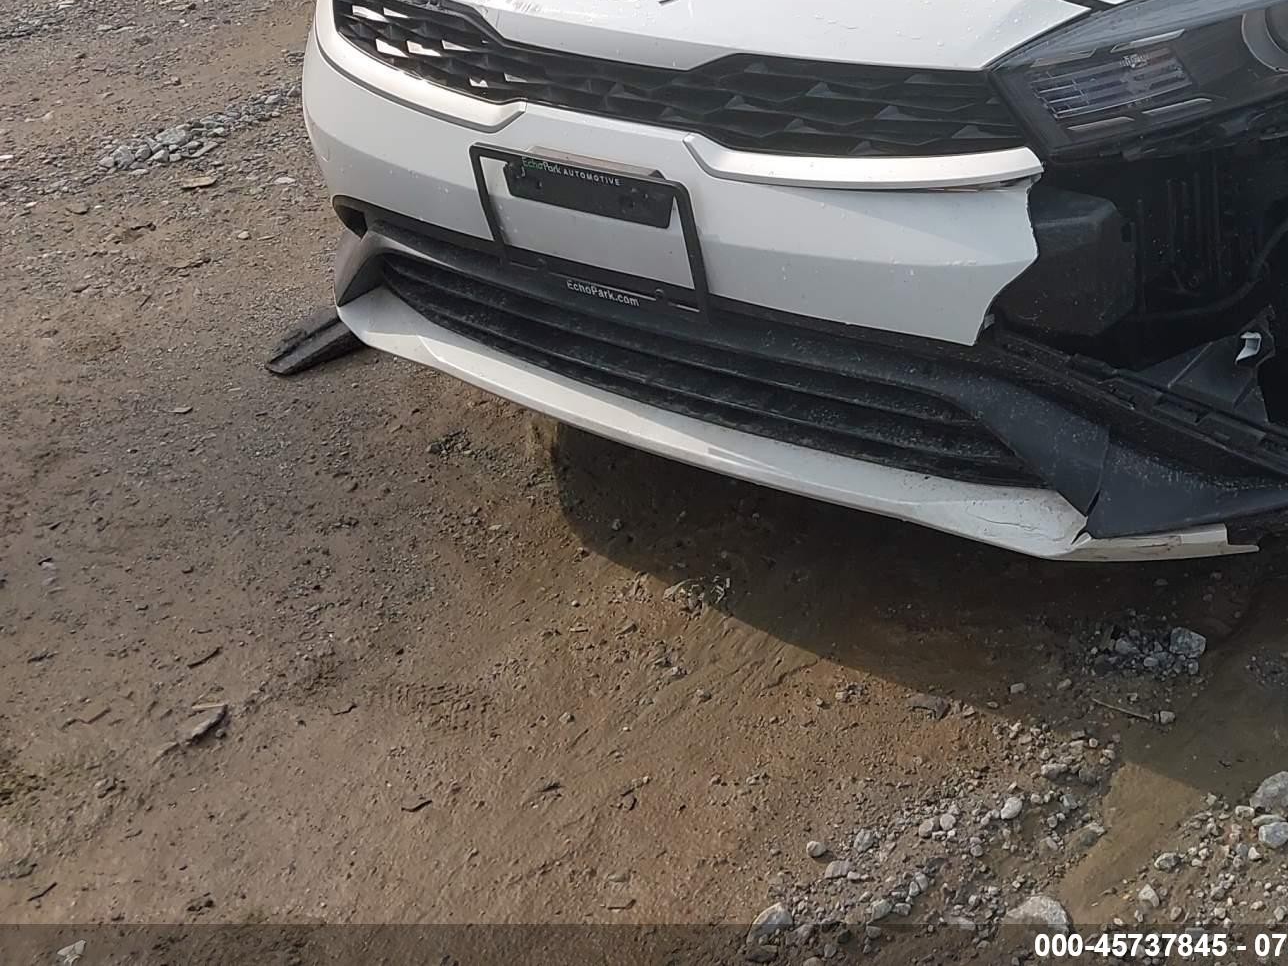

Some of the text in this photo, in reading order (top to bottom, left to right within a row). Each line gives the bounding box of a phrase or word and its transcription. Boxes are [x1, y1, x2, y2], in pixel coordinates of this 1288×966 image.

[521, 156, 621, 186] EchoPark AUTOMOTIVE
[566, 279, 640, 307] EchoPark.com
